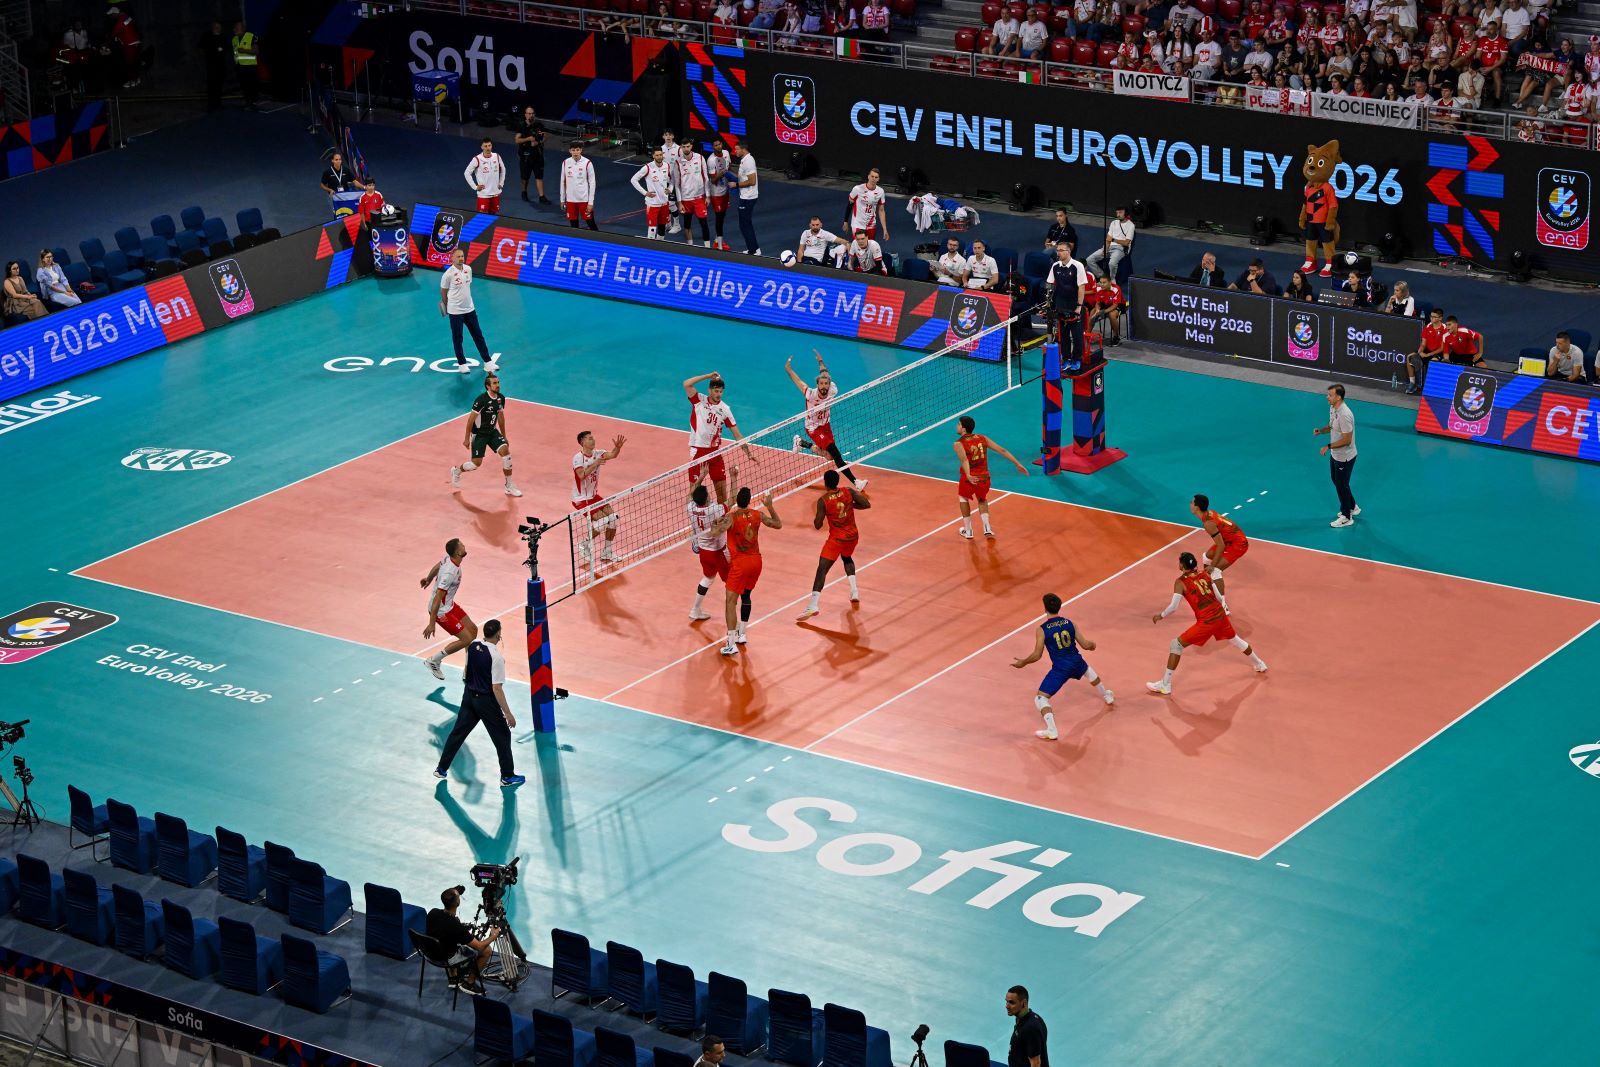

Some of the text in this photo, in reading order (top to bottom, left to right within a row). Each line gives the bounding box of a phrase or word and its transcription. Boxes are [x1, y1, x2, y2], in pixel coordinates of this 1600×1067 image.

[408, 30, 527, 91] Sofia
[784, 79, 802, 88] CEV
[1119, 73, 1183, 91] MOTYCZ
[1320, 97, 1411, 120] ZŁOCIENIEC
[782, 130, 809, 143] enel
[850, 100, 1403, 205] CEV ENEL EUROVOLLEY 026
[1552, 174, 1576, 184] CEV
[1544, 232, 1580, 247] enel
[496, 238, 894, 326] CEV Enel EuroVolley 2026 Men
[1170, 293, 1229, 313] CEV Enel
[1147, 306, 1252, 334] EuroVolley 2026
[0, 296, 192, 380] ey 2026 Men
[1185, 328, 1214, 344] Men
[1347, 326, 1382, 344] Sofia
[1346, 342, 1406, 364] Bulgaria
[1468, 376, 1487, 386] CEV
[1454, 421, 1482, 434] enel
[1545, 405, 1600, 442] CE
[54, 607, 95, 620] CEV
[1053, 630, 1071, 650] 10
[126, 644, 227, 672] CEV Enel
[96, 654, 273, 704] EuroVolley 2026
[721, 797, 1146, 938] Sofia
[168, 1007, 203, 1031] Sofia
